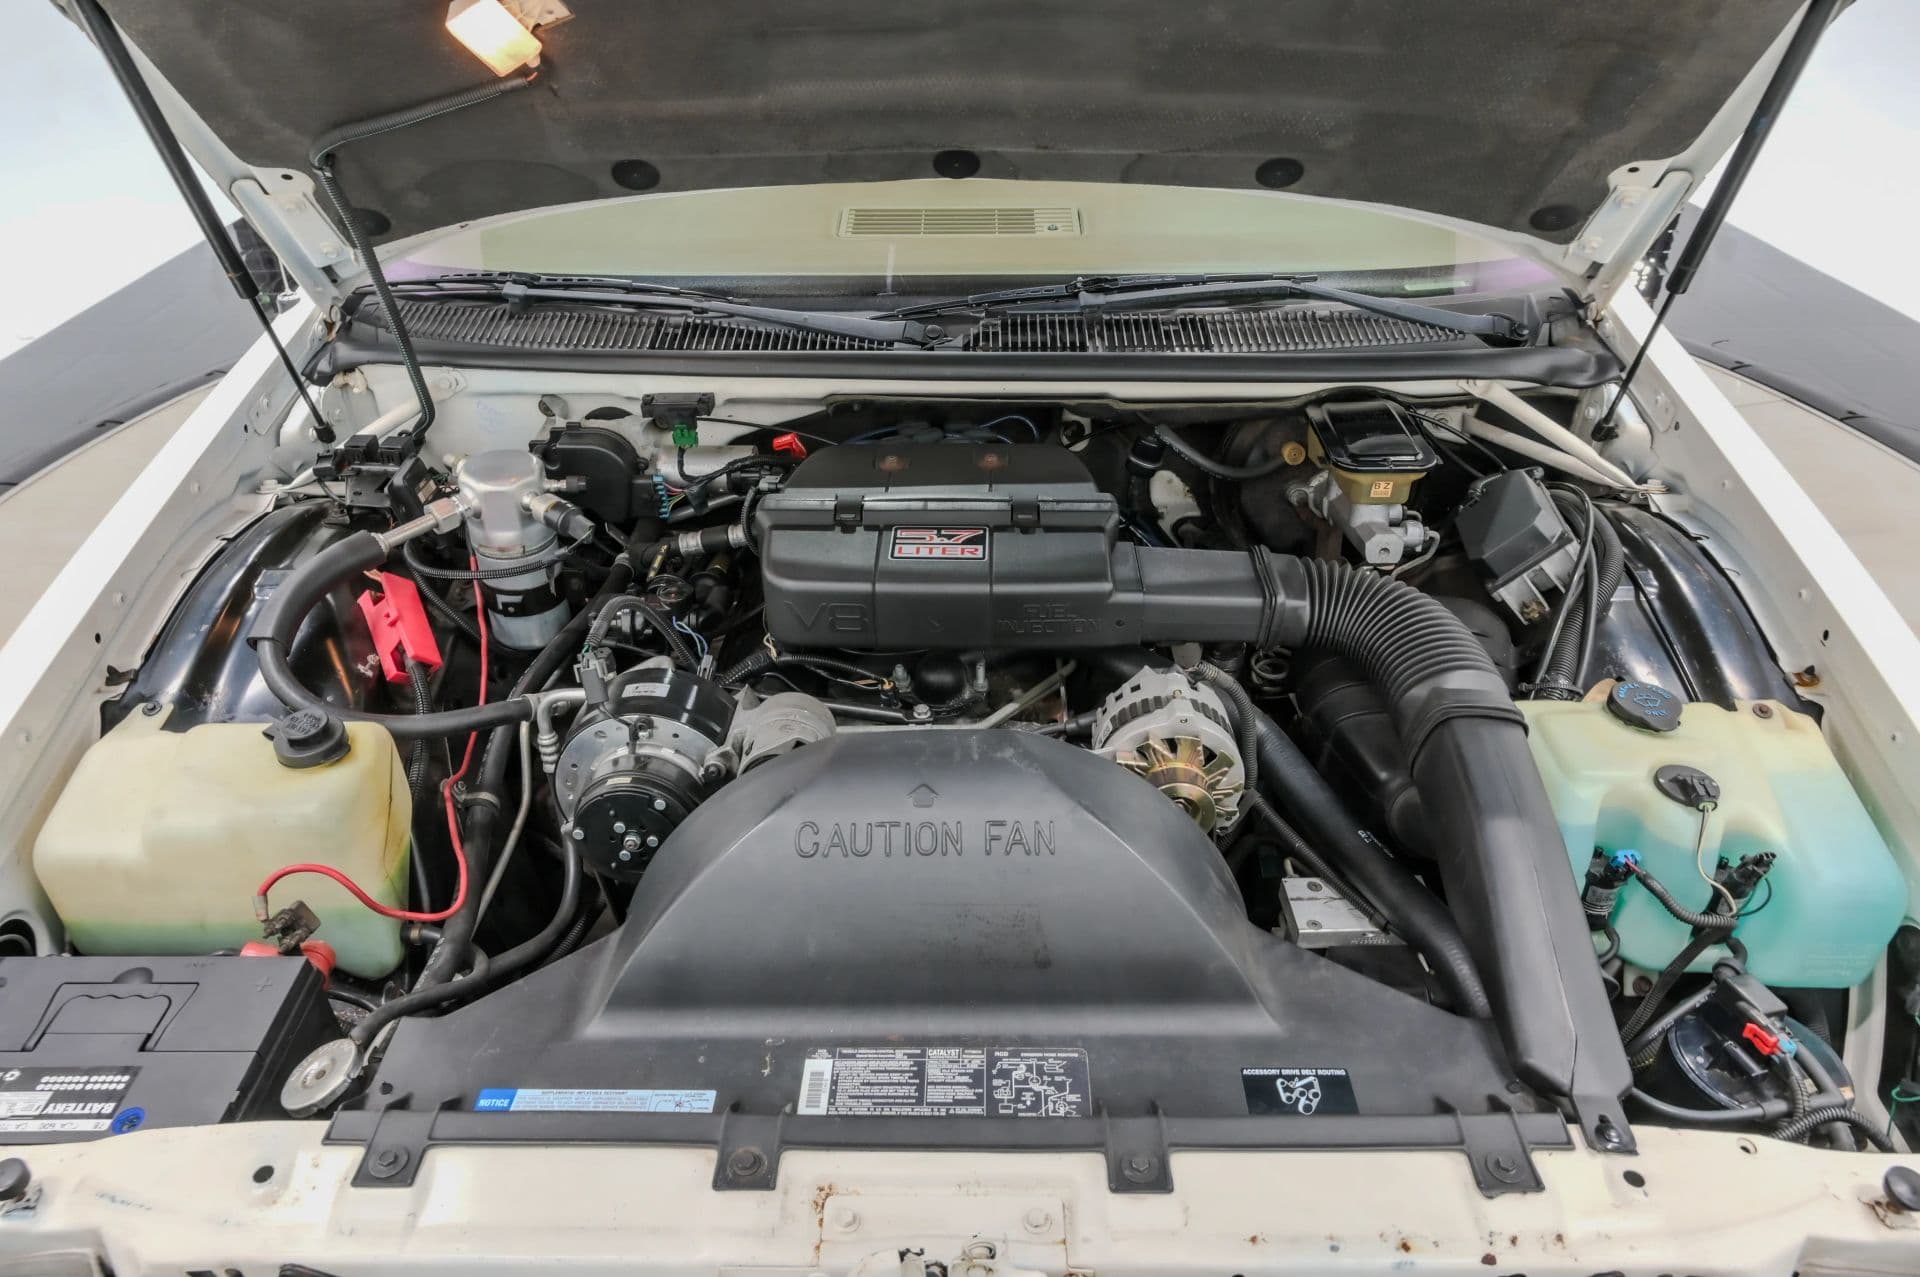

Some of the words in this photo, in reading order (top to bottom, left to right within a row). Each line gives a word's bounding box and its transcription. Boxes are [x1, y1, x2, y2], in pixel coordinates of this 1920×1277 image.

[895, 529, 984, 544] 5.7
[897, 546, 980, 556] LITER
[784, 601, 871, 632] V8
[1023, 604, 1078, 618] FUEL
[997, 619, 1102, 634] INJECTION
[794, 820, 963, 858] CAUTION
[983, 820, 1056, 856] FAN
[928, 1048, 960, 1057] CATALYST
[41, 1102, 117, 1114] BATTERY
[478, 1098, 511, 1108] NOTICE
